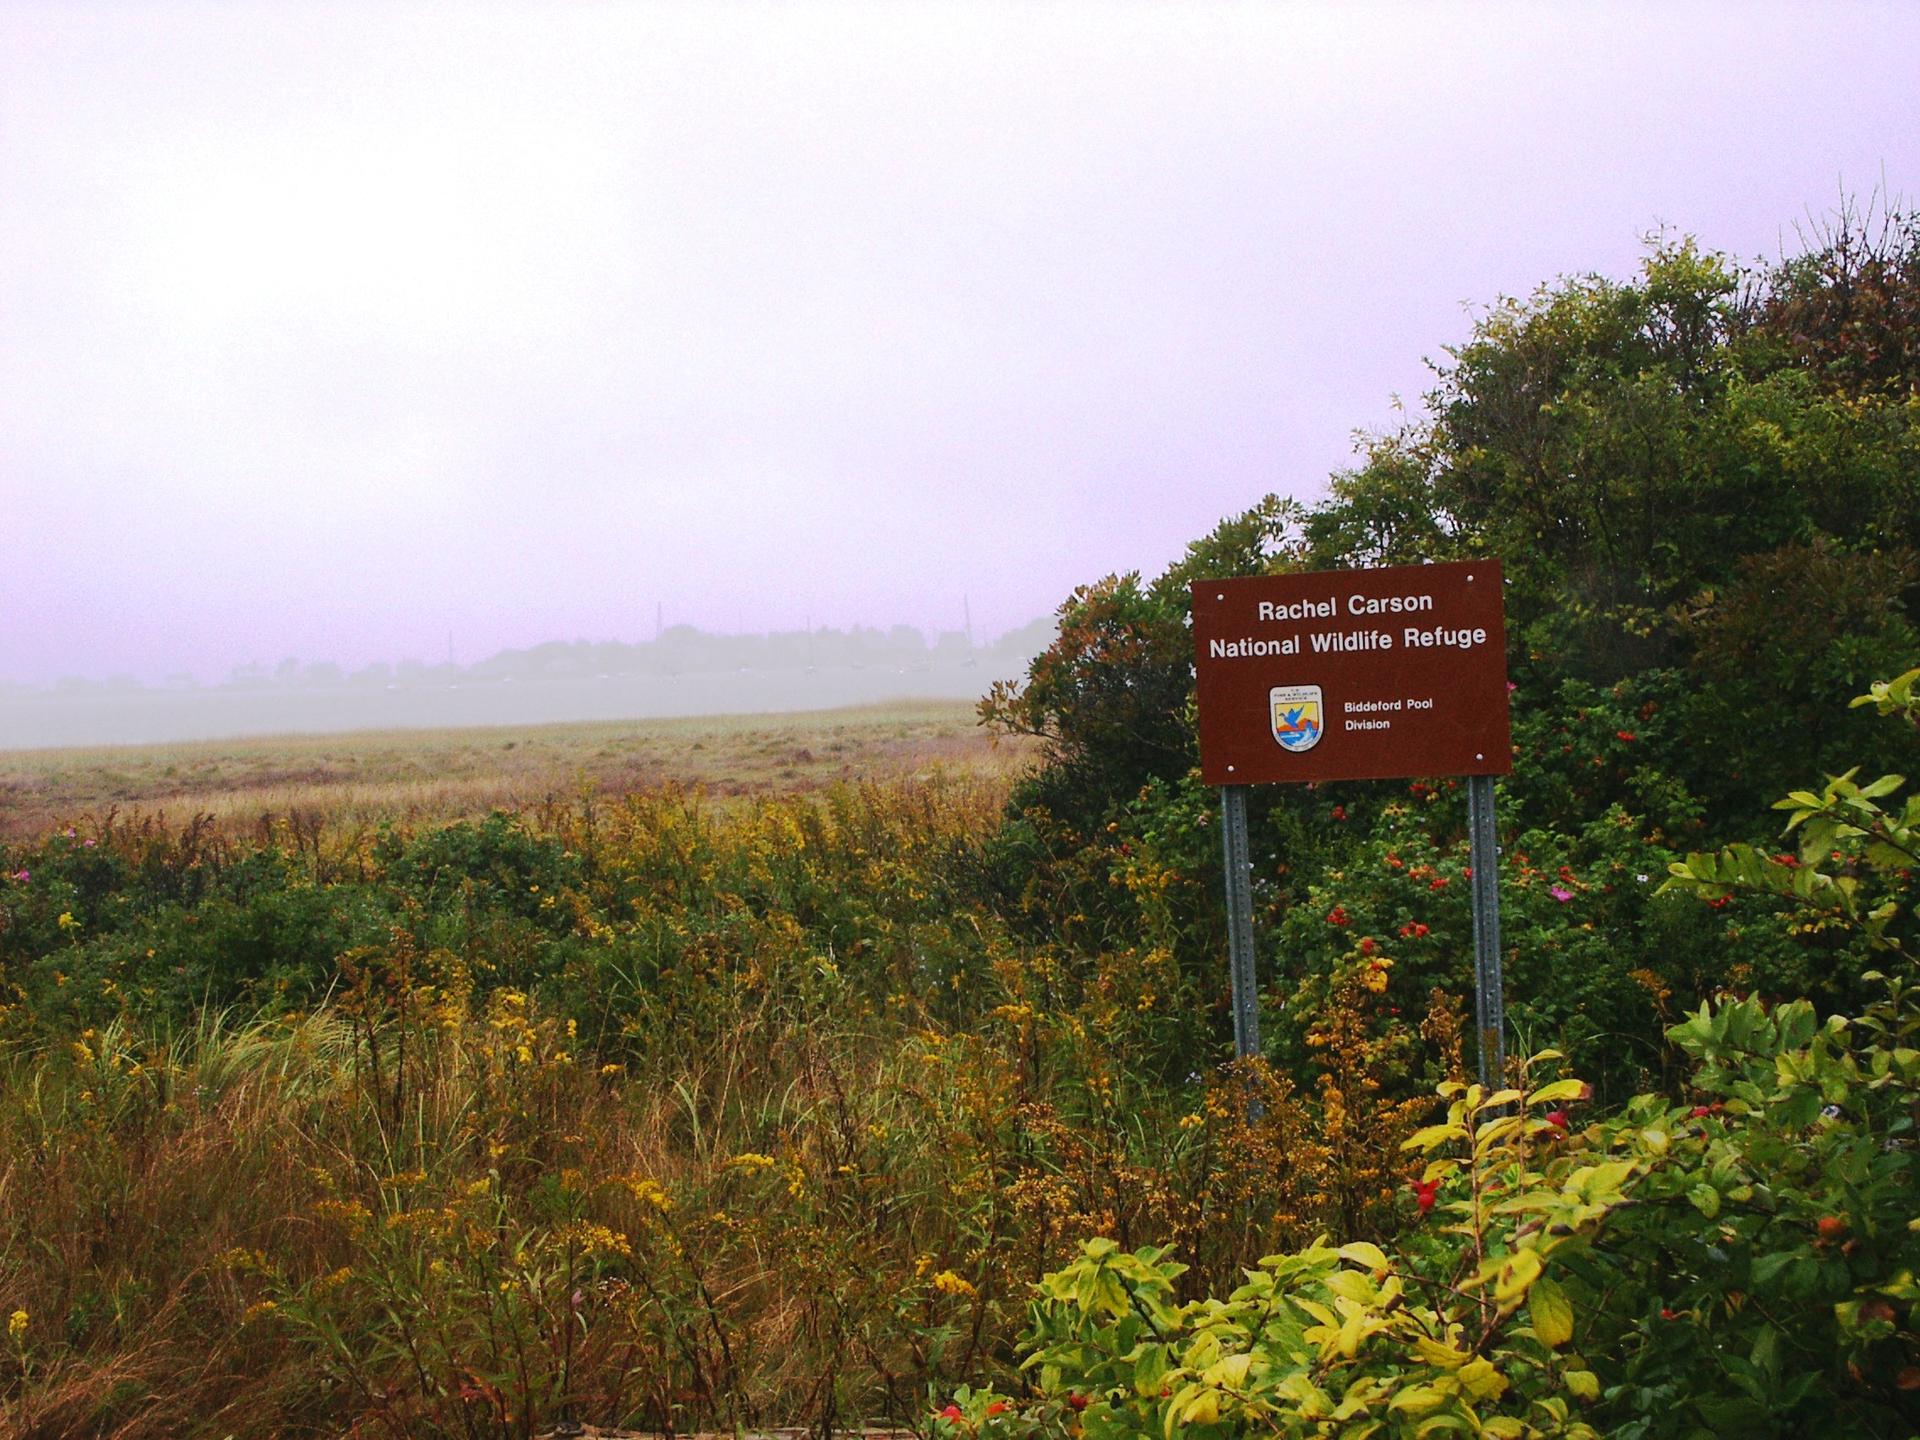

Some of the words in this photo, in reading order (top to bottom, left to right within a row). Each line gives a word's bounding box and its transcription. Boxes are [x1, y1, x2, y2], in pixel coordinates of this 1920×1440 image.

[1258, 596, 1337, 621] Rachel
[1348, 594, 1433, 615] Carson
[1209, 634, 1300, 658] National
[1310, 630, 1393, 653] Wildlife
[1404, 626, 1487, 649] Refuge
[1344, 699, 1402, 713] Biddeford
[1406, 698, 1433, 711] Pool
[1345, 718, 1391, 731] Division
